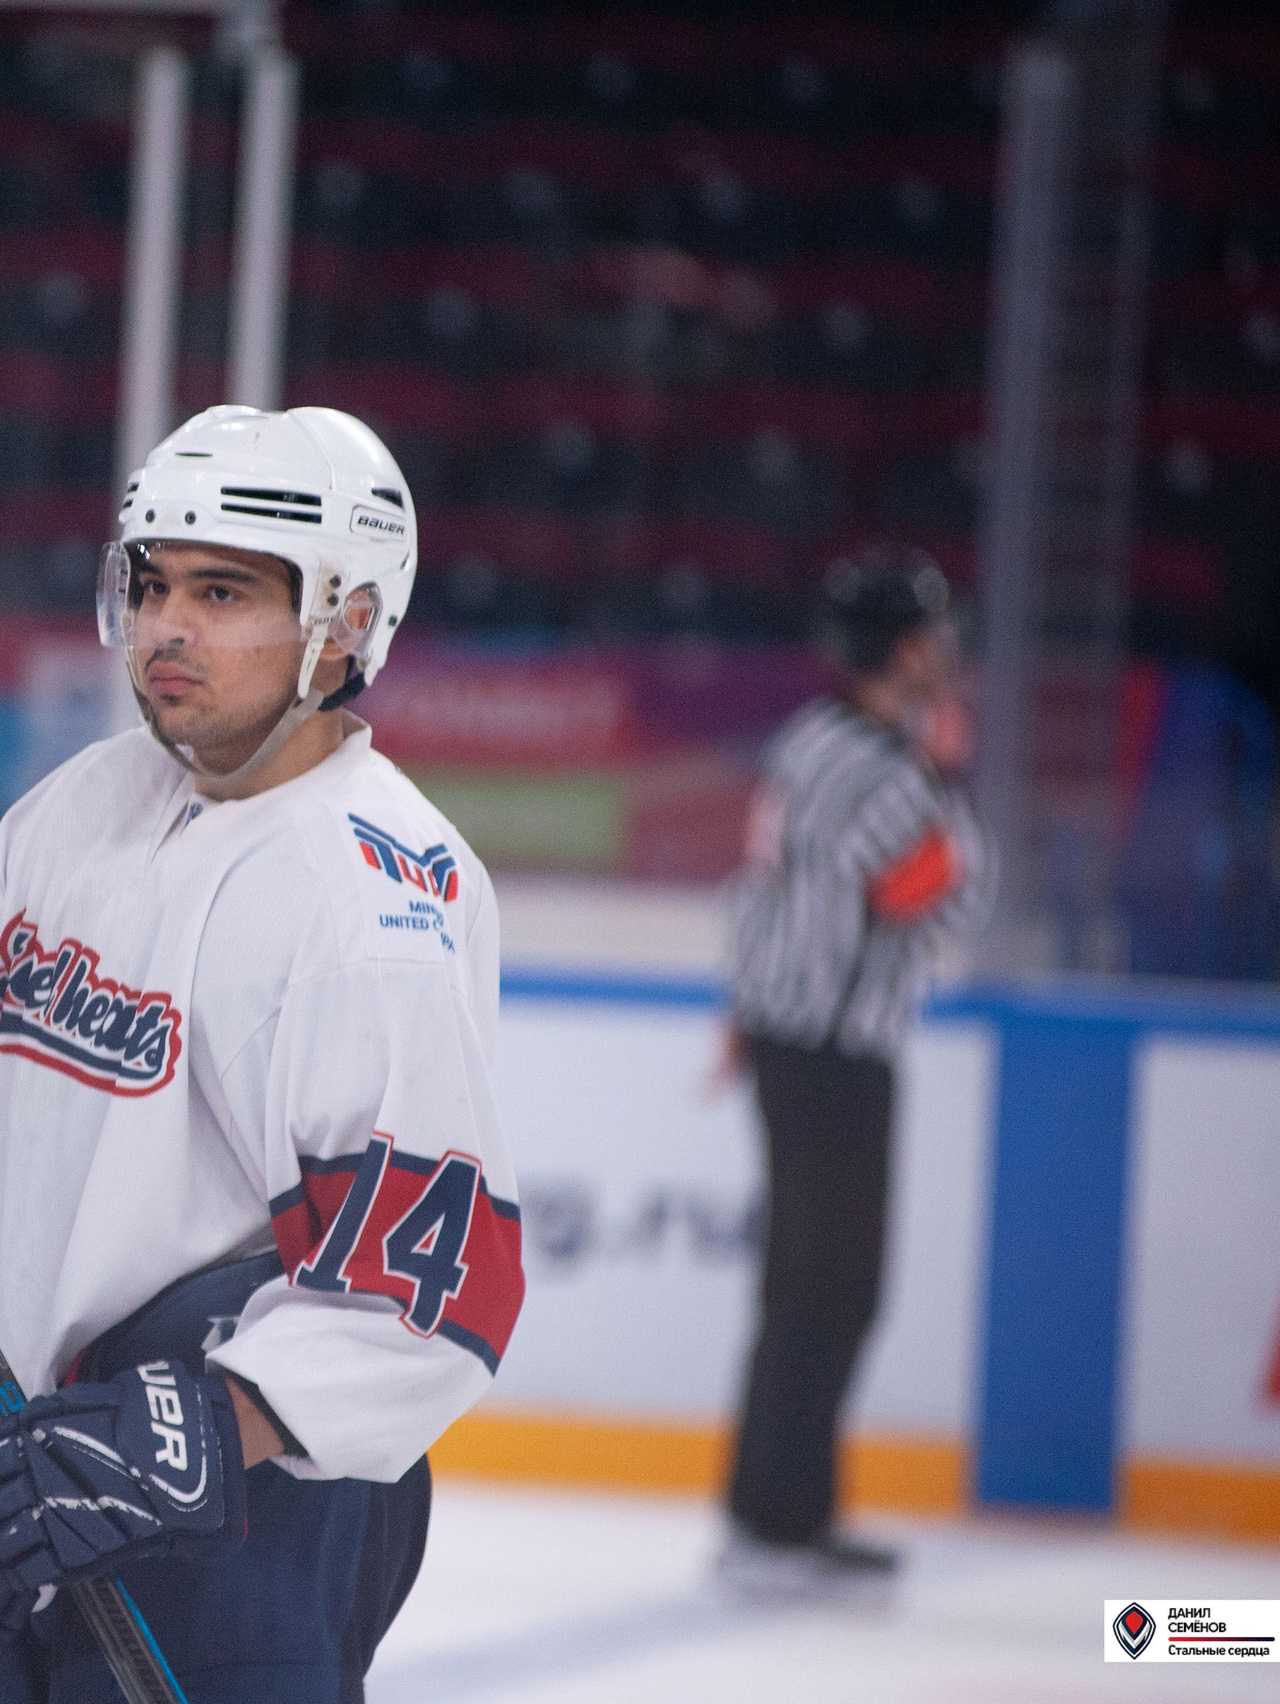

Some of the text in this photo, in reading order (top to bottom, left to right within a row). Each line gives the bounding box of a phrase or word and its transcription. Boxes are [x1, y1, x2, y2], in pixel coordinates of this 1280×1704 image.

[379, 913, 430, 932] UNITED
[291, 1131, 483, 1338] 14
[137, 1360, 187, 1472] UER
